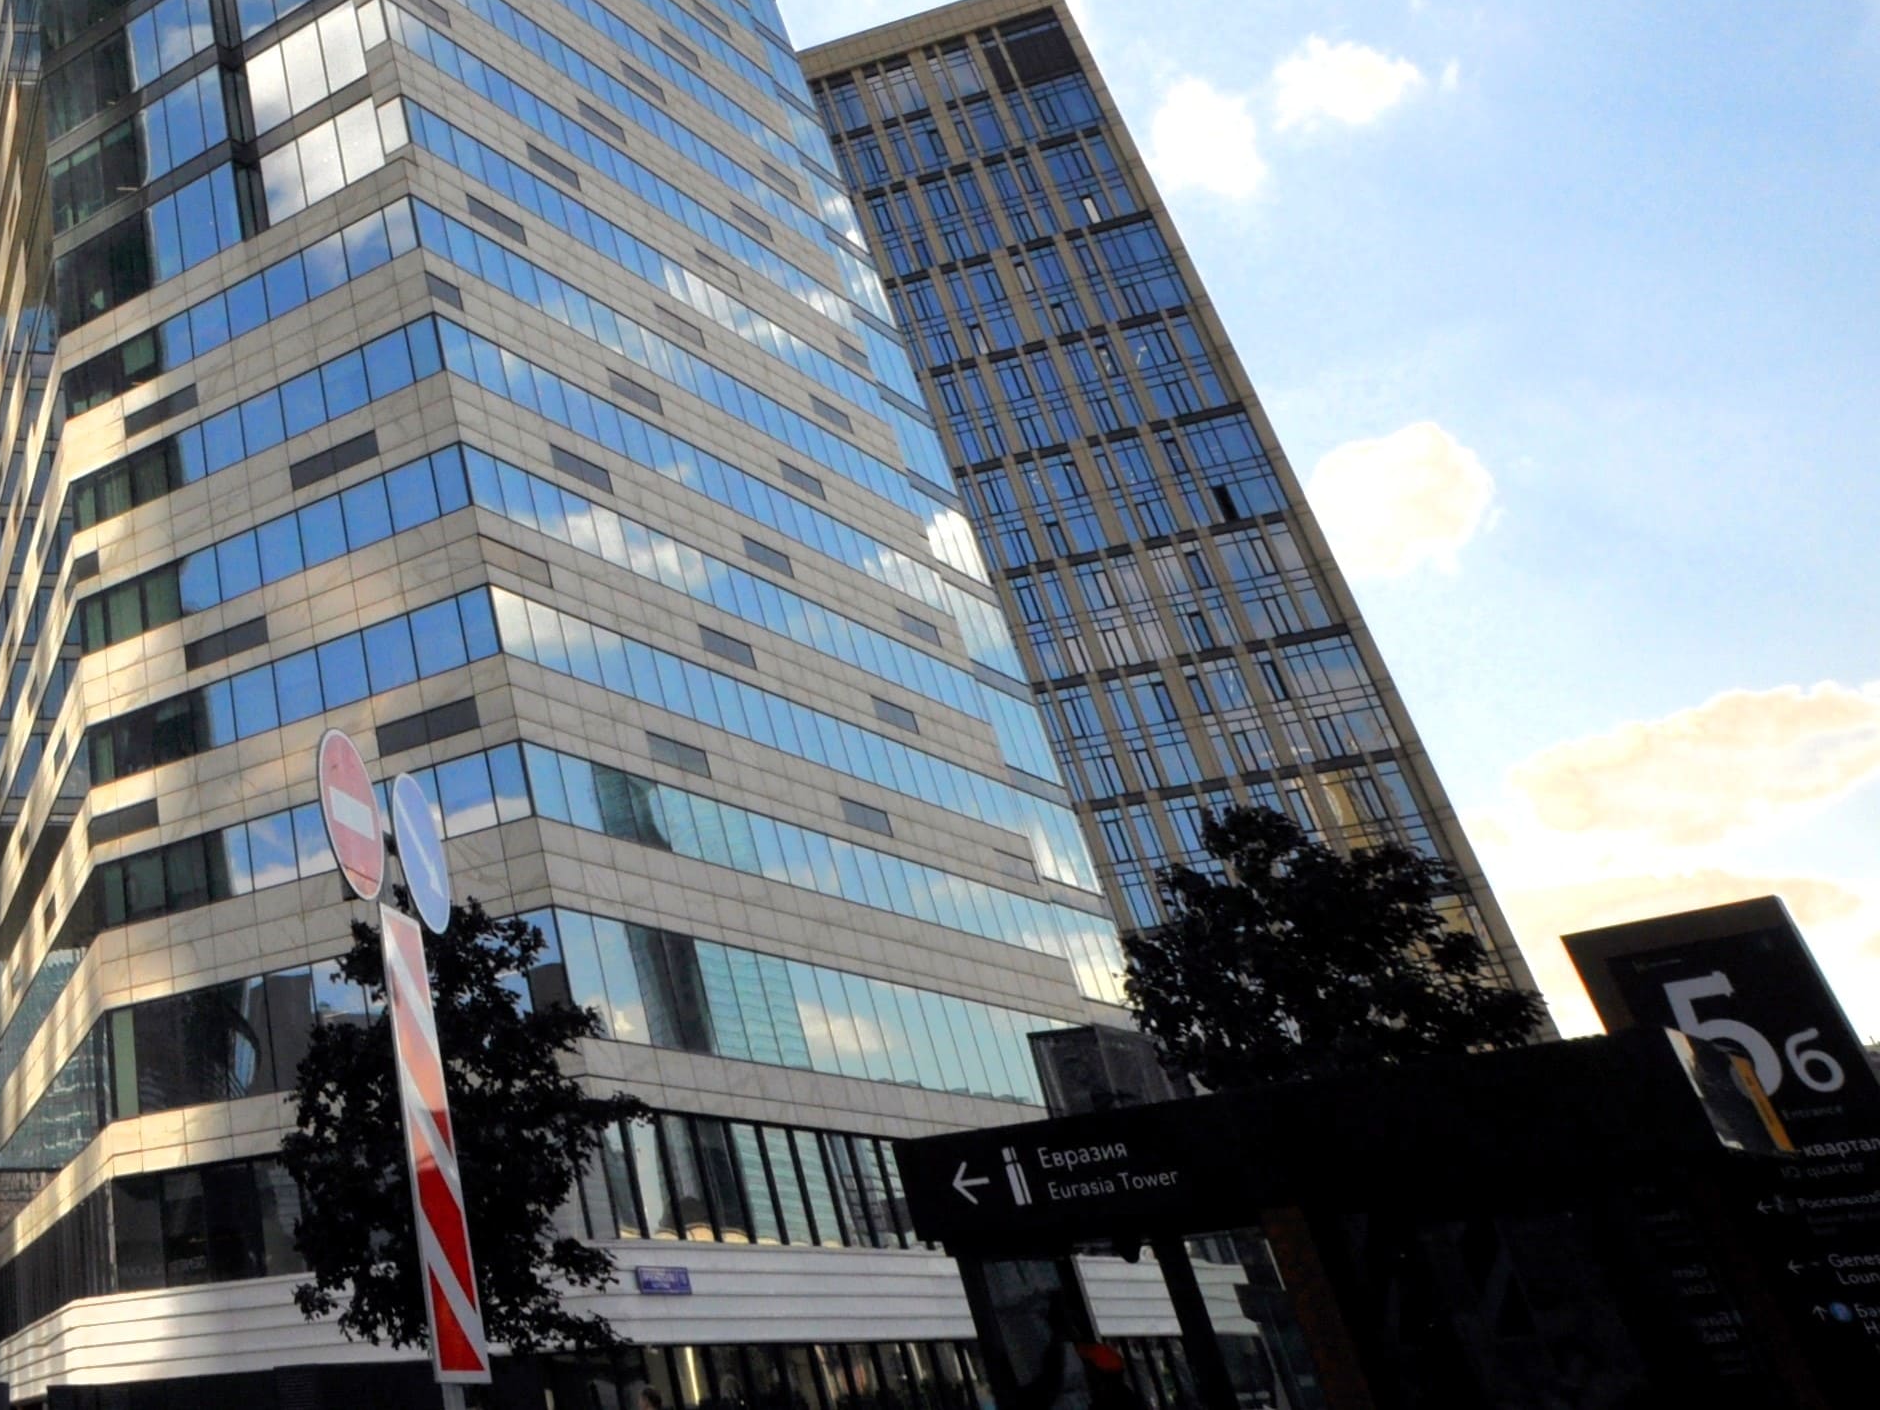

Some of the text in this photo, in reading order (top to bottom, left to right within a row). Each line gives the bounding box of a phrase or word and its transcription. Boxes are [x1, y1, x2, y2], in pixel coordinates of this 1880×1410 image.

[1036, 1142, 1129, 1172] Евразия
[1806, 1160, 1865, 1180] quarter
[1047, 1170, 1180, 1201] Eurasia Tower
